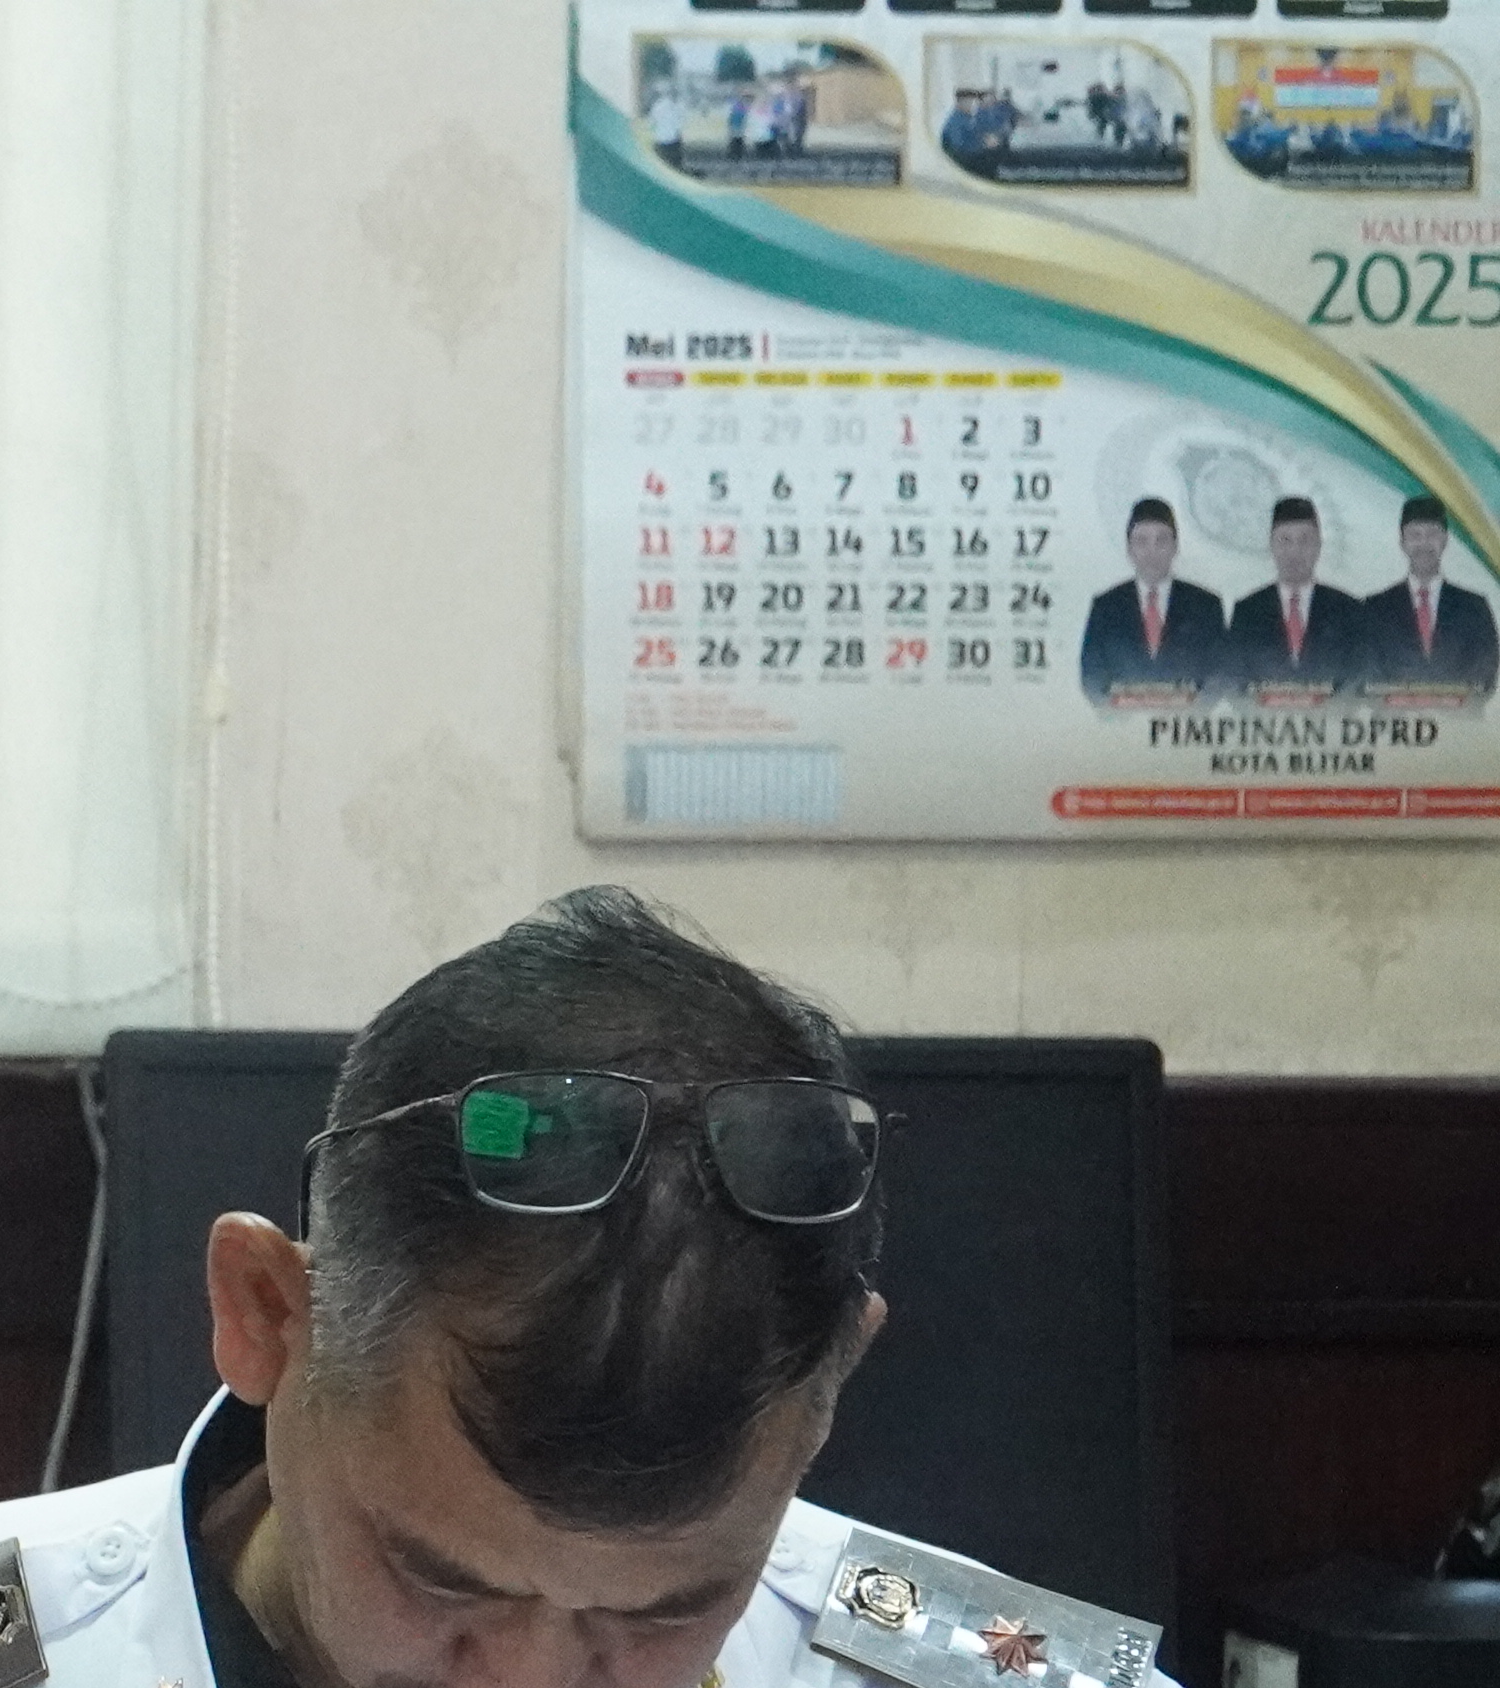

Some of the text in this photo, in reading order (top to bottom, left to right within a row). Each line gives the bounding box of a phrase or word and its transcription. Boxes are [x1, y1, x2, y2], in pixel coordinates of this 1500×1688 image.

[1308, 251, 1500, 328] 2025
[625, 333, 674, 356] Mei
[687, 334, 753, 358] 2025
[900, 415, 914, 446] 1
[960, 415, 979, 446] 2
[1022, 415, 1041, 446] 3
[645, 470, 1052, 501] 4 5 6 7 8 9 10
[639, 527, 1049, 557] 11 12 13 14 15 16 17
[638, 582, 1053, 613] 18 19 20 21 22 23 24
[634, 638, 1048, 669] 25 26 27 28 29 30 31
[1148, 717, 1439, 748] PIMPINAN DPRD
[1210, 752, 1376, 774] KOTA BLITAR
